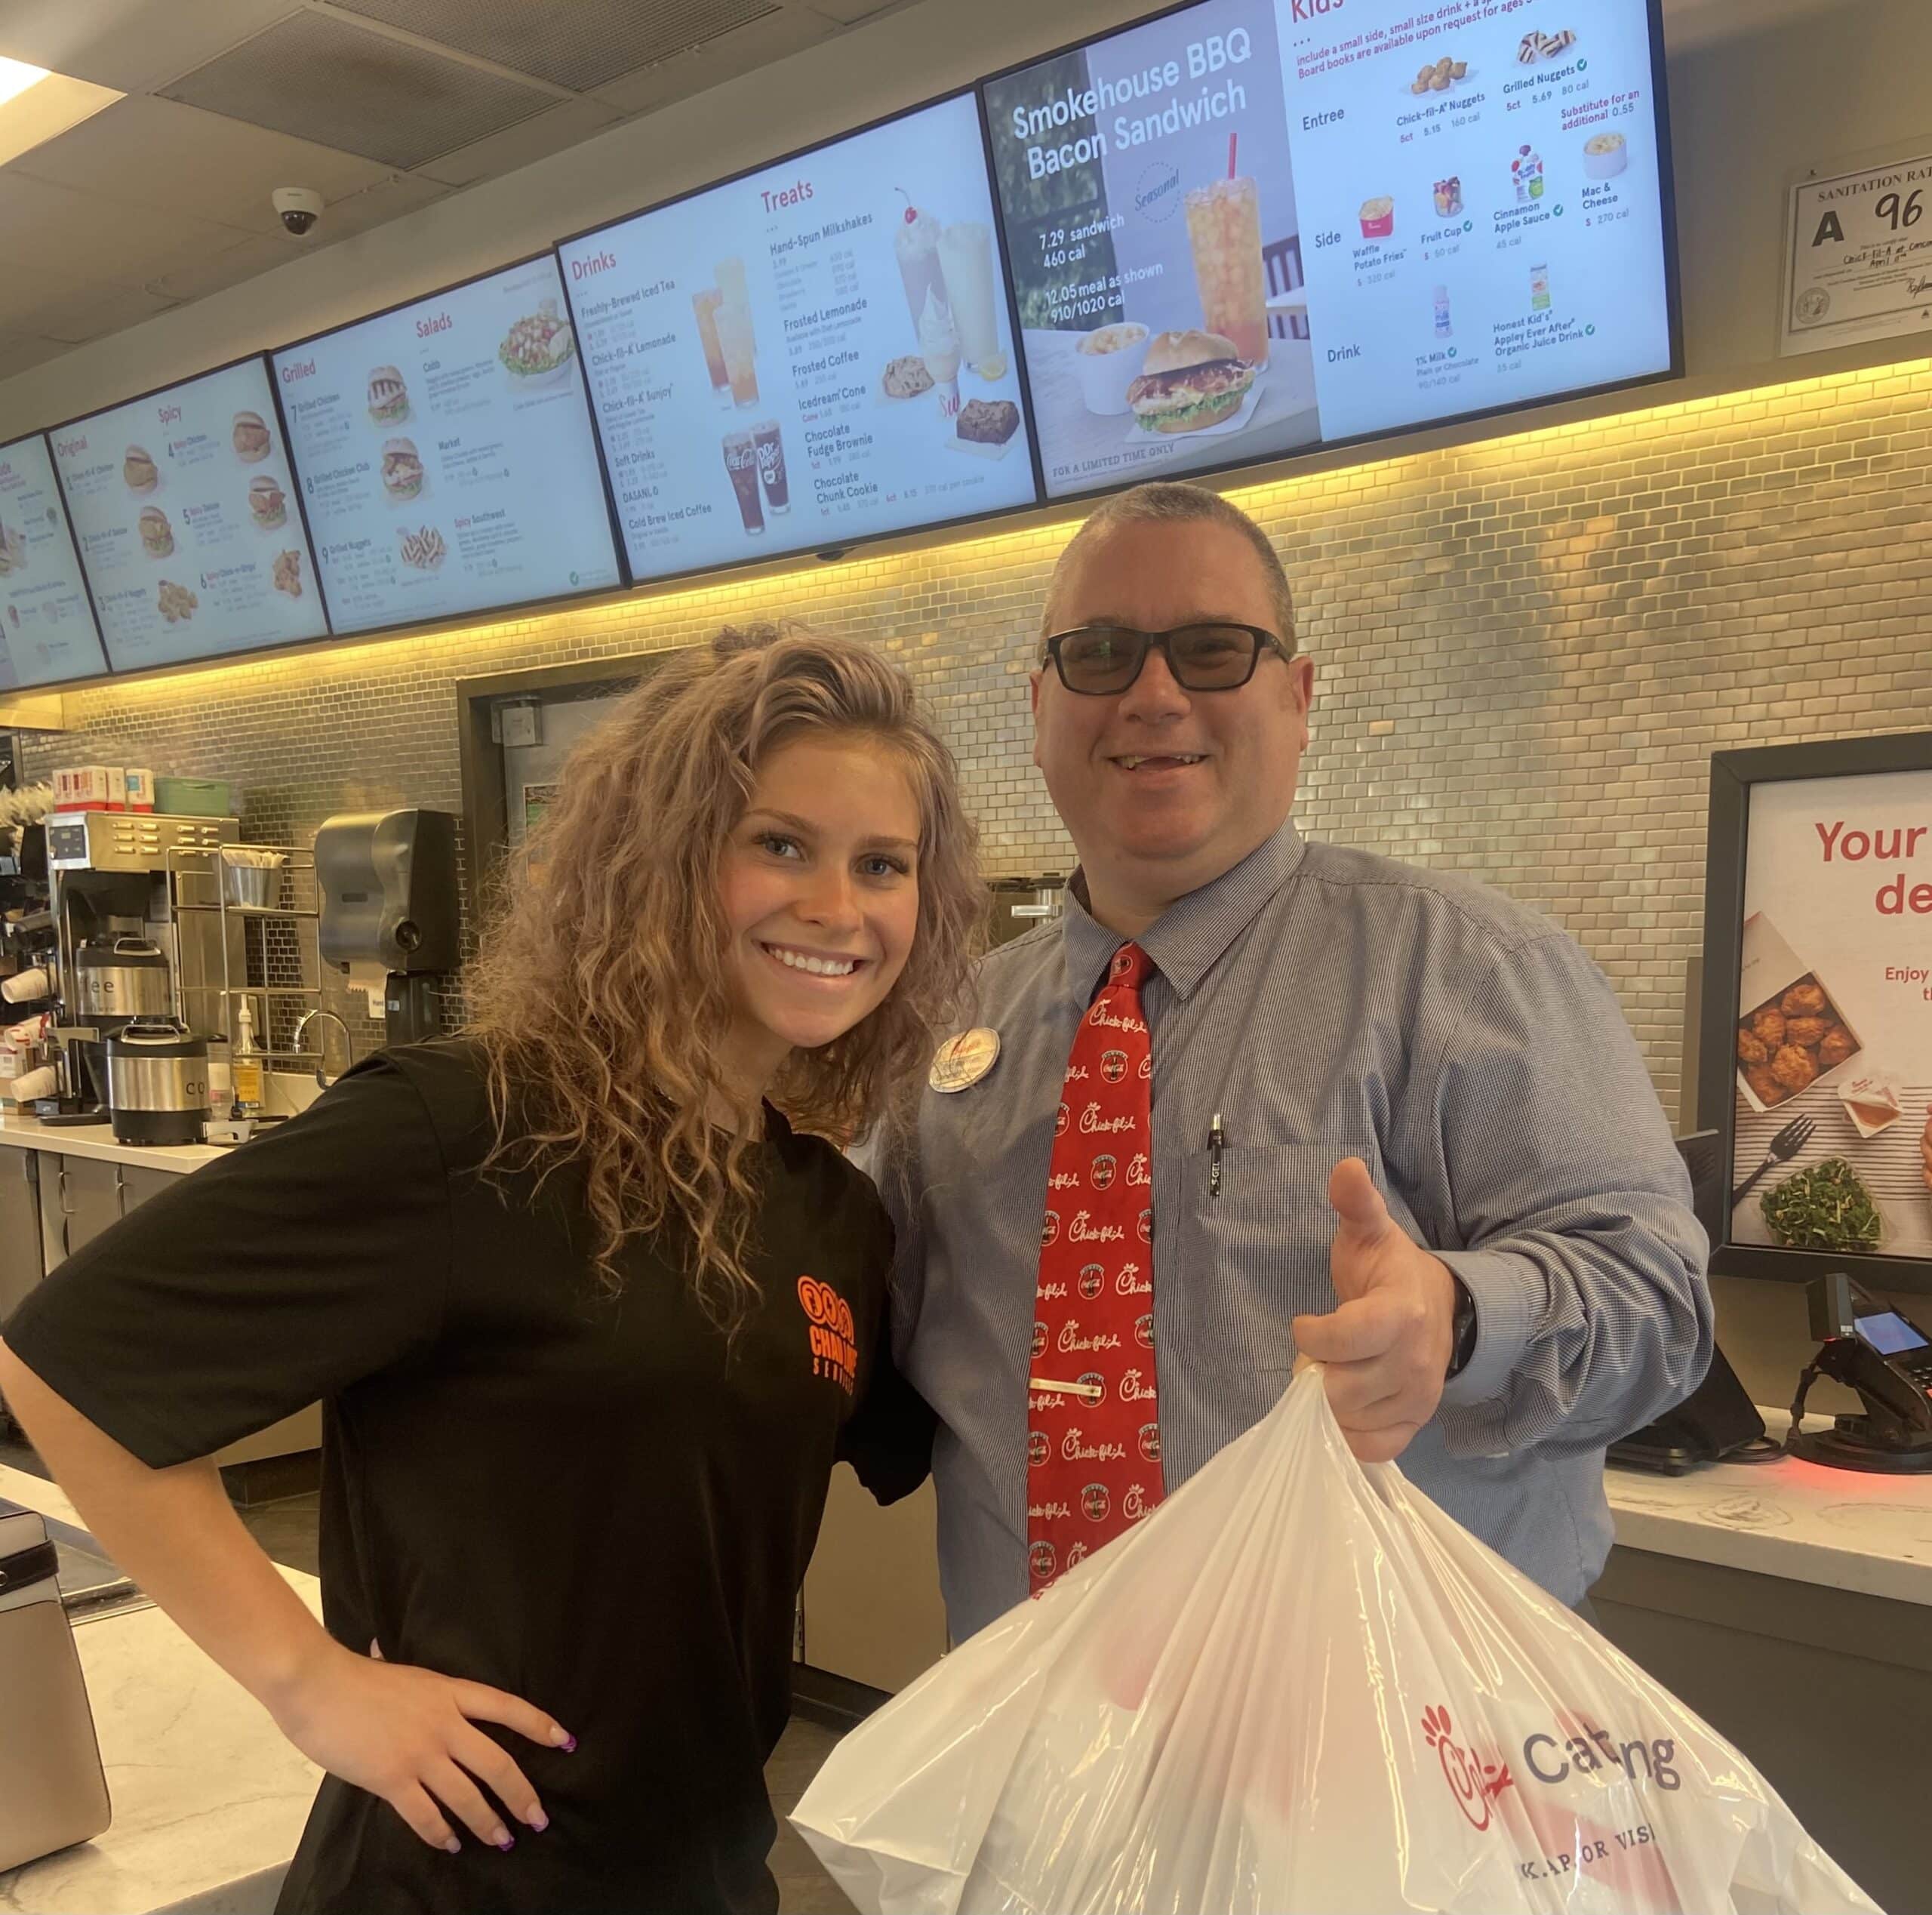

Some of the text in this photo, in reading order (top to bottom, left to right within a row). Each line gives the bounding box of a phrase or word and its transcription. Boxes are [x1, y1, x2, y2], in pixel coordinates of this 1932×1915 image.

[1297, 48, 1330, 66] include
[1332, 47, 1337, 55] a
[1340, 33, 1363, 53] small
[1365, 29, 1387, 49] side,
[1389, 16, 1414, 35] small
[1417, 13, 1434, 29] size
[1437, 2, 1462, 19] drink
[1298, 0, 1524, 79] Board books are available upon request for ages
[1013, 27, 1252, 140] Smokehouse BBQ
[1503, 66, 1576, 94] Grilled Nuggets
[1449, 94, 1485, 111] Nuggets
[1506, 80, 1589, 112] 5ct 5.69 80 cal
[1561, 90, 1640, 119] Substitute for an
[1027, 79, 1247, 180] Bacon Sandwich
[1303, 109, 1345, 131] Entree
[1400, 133, 1413, 143] 5ct
[1451, 117, 1466, 128] 160
[1468, 112, 1481, 124] cal
[1561, 103, 1635, 131] additional 0.55
[1134, 169, 1180, 212] Seasonal
[1582, 183, 1611, 198] Mac &
[1817, 165, 1932, 203] SANITATION RAT
[761, 180, 814, 214] Treats
[1583, 193, 1618, 210] Cheese
[1875, 189, 1924, 230] 96
[1494, 203, 1540, 221] Cinnamon
[1494, 212, 1550, 234] Apple Sauce
[1586, 209, 1629, 227] S 270 cal
[770, 213, 873, 256] Hand-Spun Milkshakes
[1039, 214, 1124, 251] 7.29 sandwich
[1315, 232, 1341, 248] Side
[1421, 227, 1463, 245] Fruit Cup
[1509, 237, 1521, 247] cal
[1811, 211, 1844, 248] A
[1043, 244, 1085, 269] 460 cal
[1352, 245, 1380, 259] Waffle
[1354, 257, 1382, 272] Potato
[571, 251, 617, 281] Drinks
[1045, 262, 1164, 306] 12.05 meal as shown
[581, 289, 641, 319] Freshly-Brewed
[641, 283, 660, 297] Iced
[660, 280, 676, 292] Tea
[1050, 291, 1125, 324] 910/1020 cal
[416, 312, 453, 339] Salads
[783, 298, 868, 333] Frosted Lemonade
[1494, 317, 1524, 333] Honest
[636, 333, 677, 353] Lemonade
[1494, 332, 1525, 347] Appley
[1527, 325, 1546, 339] Ever
[1495, 328, 1584, 357] Organic Juice Drink
[792, 351, 859, 377] Frosted Coffee
[1327, 344, 1361, 363] Drink
[1429, 351, 1447, 362] Milk
[282, 358, 316, 383] Grilled
[841, 386, 866, 399] Cone
[158, 405, 181, 427] Spicy
[291, 405, 297, 423] 7
[804, 423, 851, 443] Chocolate
[808, 433, 873, 458] Fudge Brownie
[57, 435, 88, 457] Original
[615, 450, 655, 468] Soft Drinks
[1052, 464, 1070, 478] FOR
[1072, 463, 1079, 475] A
[1081, 454, 1121, 473] LIMITED
[1122, 449, 1146, 463] TIME
[1149, 441, 1175, 457] ONLY
[306, 477, 314, 494] 8
[814, 472, 859, 490] Chocolate
[817, 482, 878, 504] Chunk Cookie
[183, 508, 190, 525] 5
[629, 503, 712, 529] Cold Brew Iced Coffee
[322, 547, 328, 564] 9
[201, 574, 207, 589] 6
[1815, 820, 1927, 862] Your
[1875, 874, 1932, 915] de
[1885, 966, 1929, 984] Enjoy
[1090, 999, 1148, 1033] Chick-fil-A
[1079, 1101, 1136, 1134] Chick-fil-A
[1069, 1210, 1124, 1243] Chick-fil-A
[1057, 1319, 1121, 1353] Chick-fil-A
[1061, 1427, 1127, 1461] Chick-fil-A
[1582, 1840, 1609, 1864] OR
